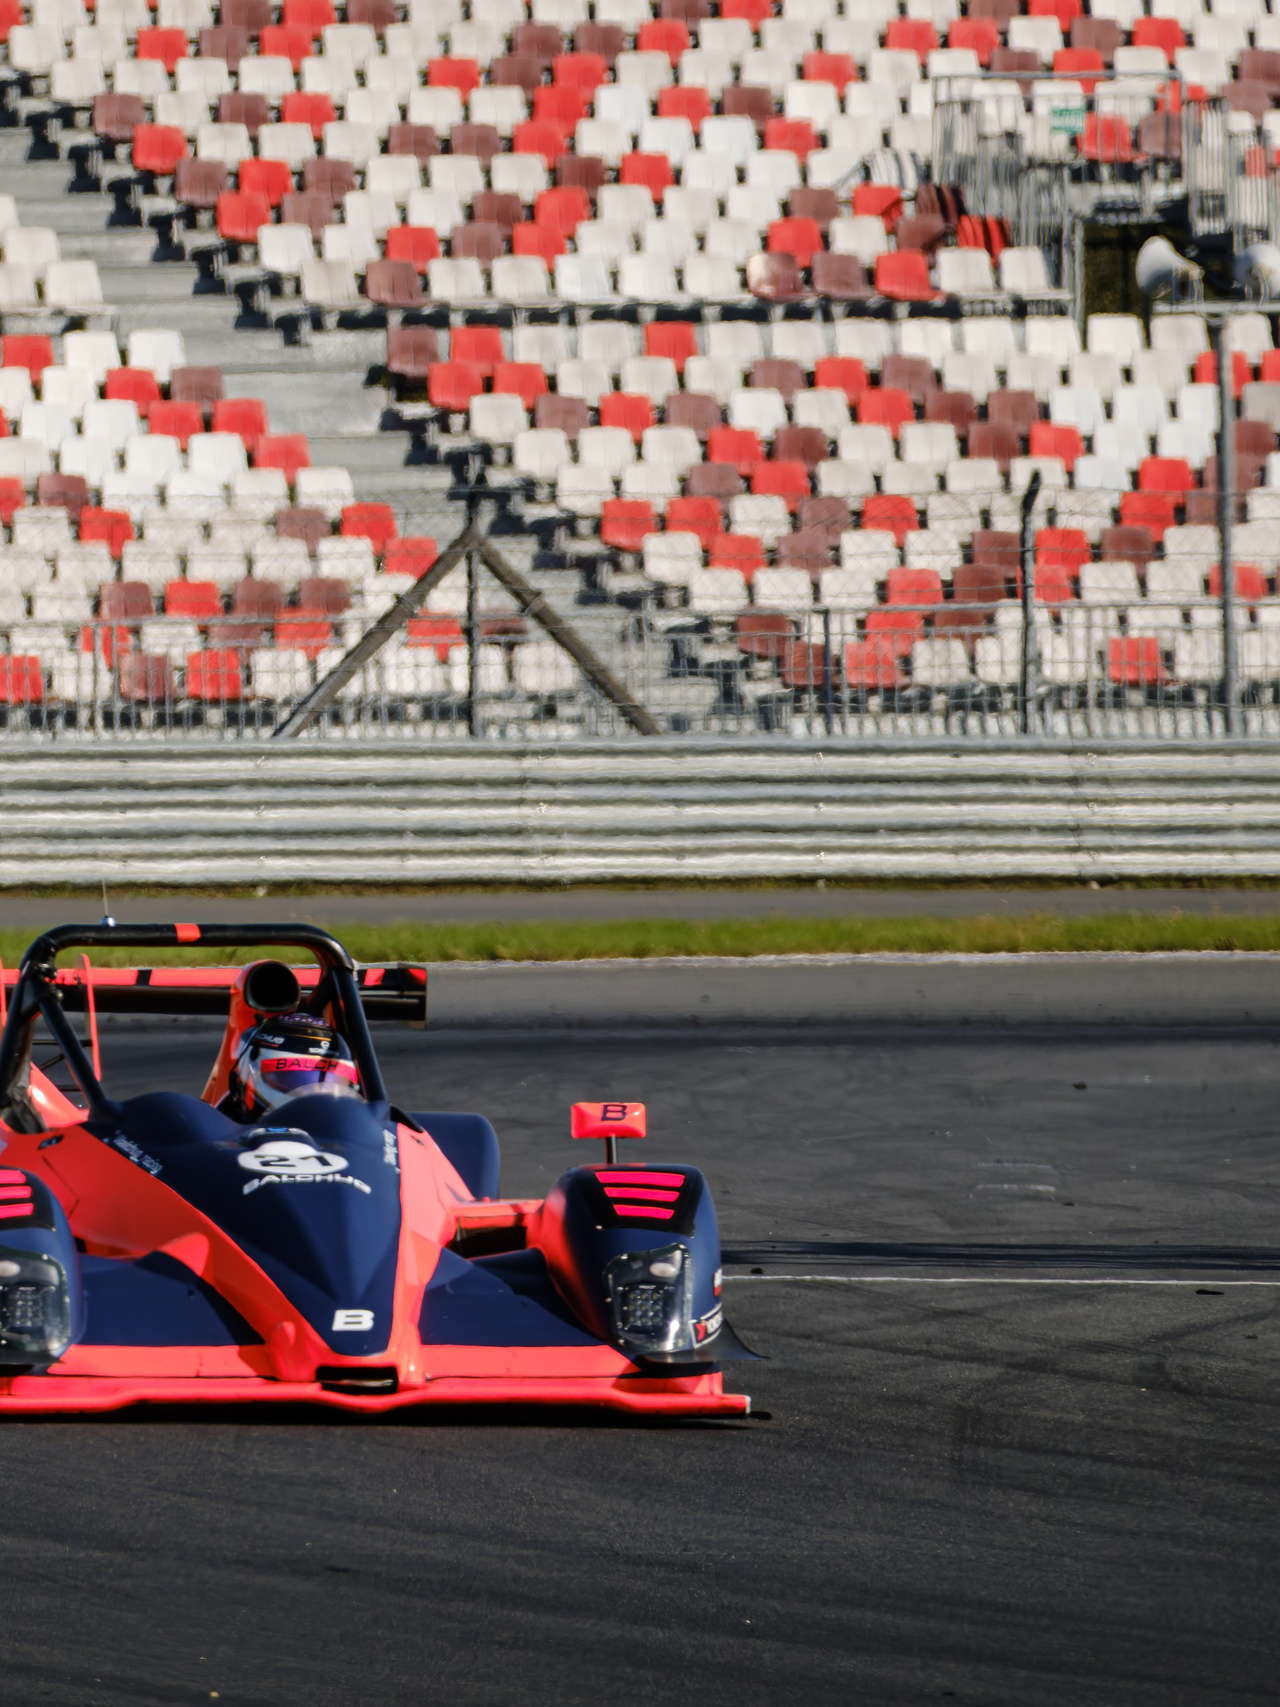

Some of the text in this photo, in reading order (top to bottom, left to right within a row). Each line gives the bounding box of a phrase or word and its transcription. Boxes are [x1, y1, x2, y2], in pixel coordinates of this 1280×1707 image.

[275, 1058, 347, 1074] BALCH
[601, 1104, 627, 1121] B
[254, 1154, 333, 1169] 21
[243, 1173, 372, 1196] BALCHUG
[331, 1309, 375, 1332] B
